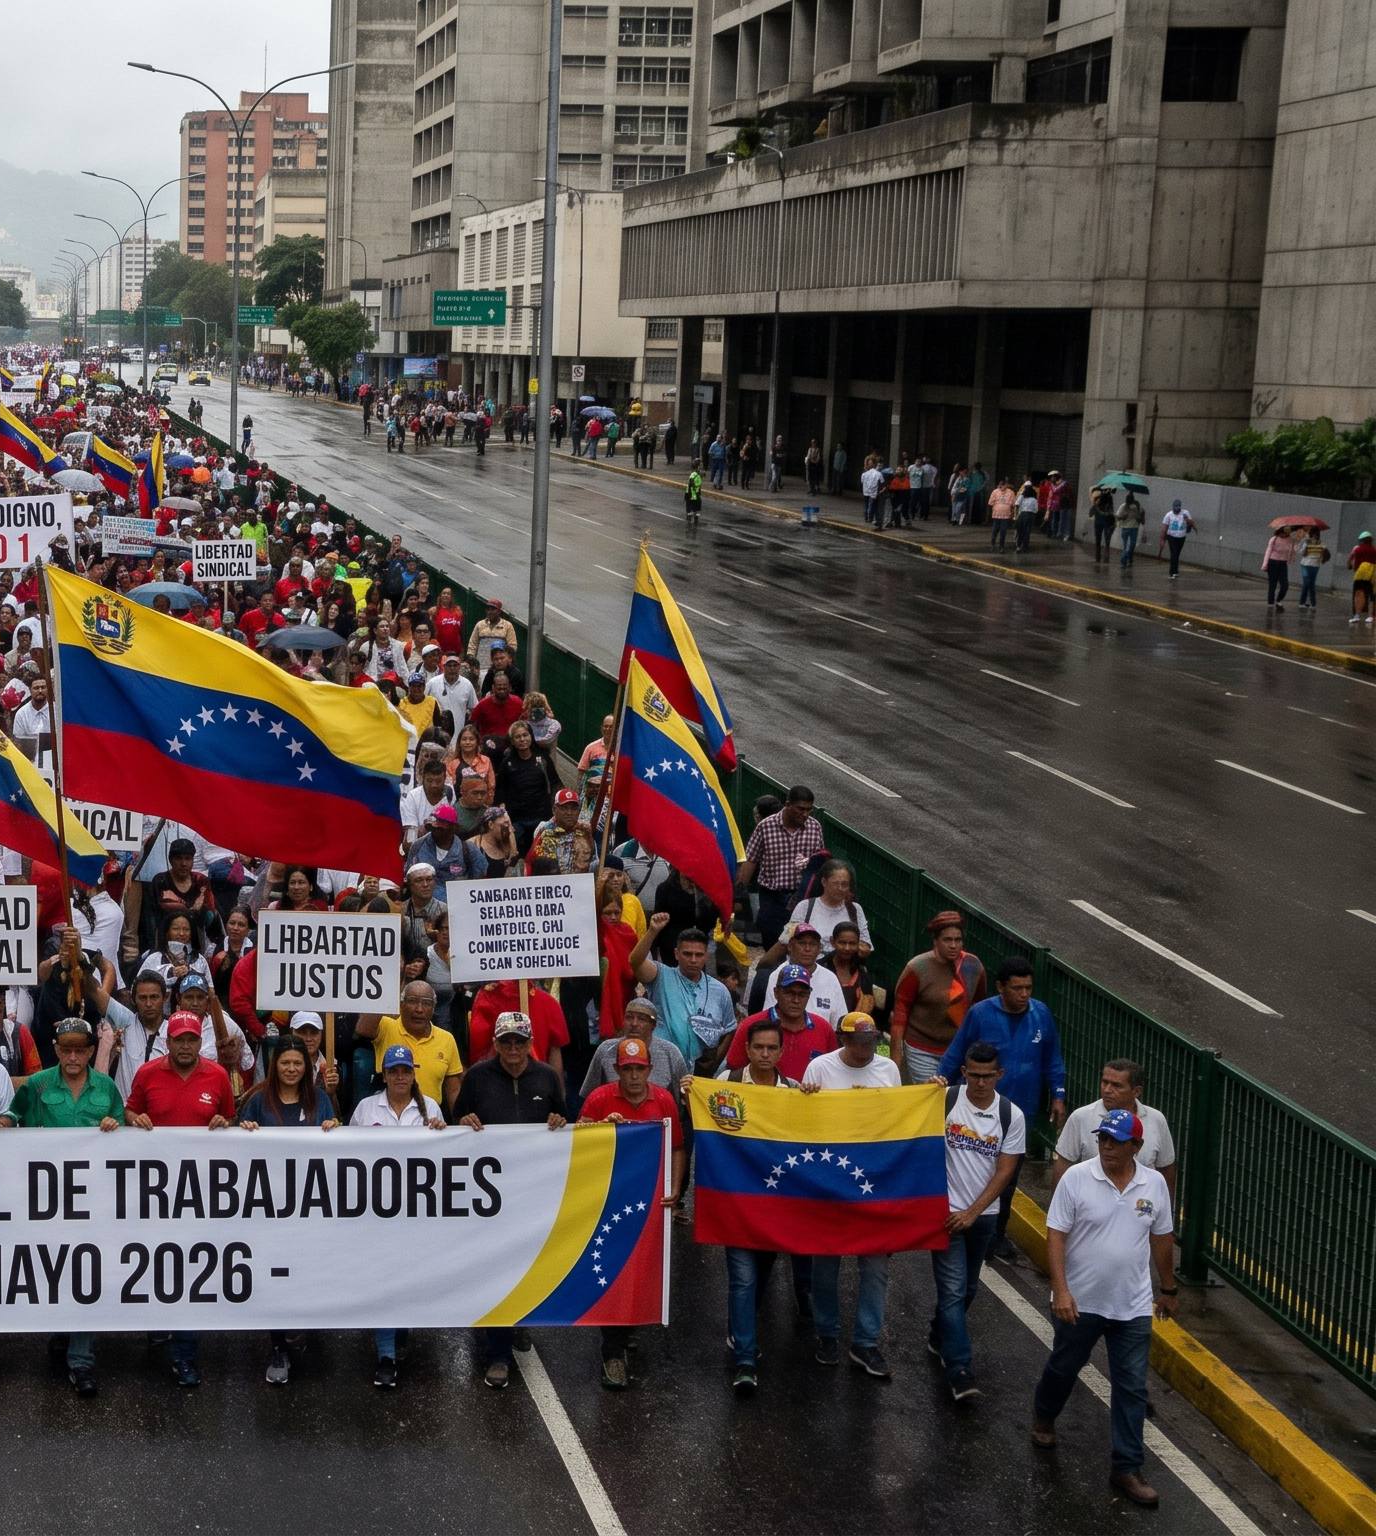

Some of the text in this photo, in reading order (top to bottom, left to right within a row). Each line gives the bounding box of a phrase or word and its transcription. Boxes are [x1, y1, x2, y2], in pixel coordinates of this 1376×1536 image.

[18, 533, 29, 562] 1
[195, 543, 253, 560] LIBERTAD
[197, 561, 252, 578] SINDICAL
[274, 962, 383, 1000] JUSTOS
[28, 1160, 90, 1221] DE
[106, 1156, 502, 1220] TRABAJADORES
[120, 1241, 253, 1304] 2026
